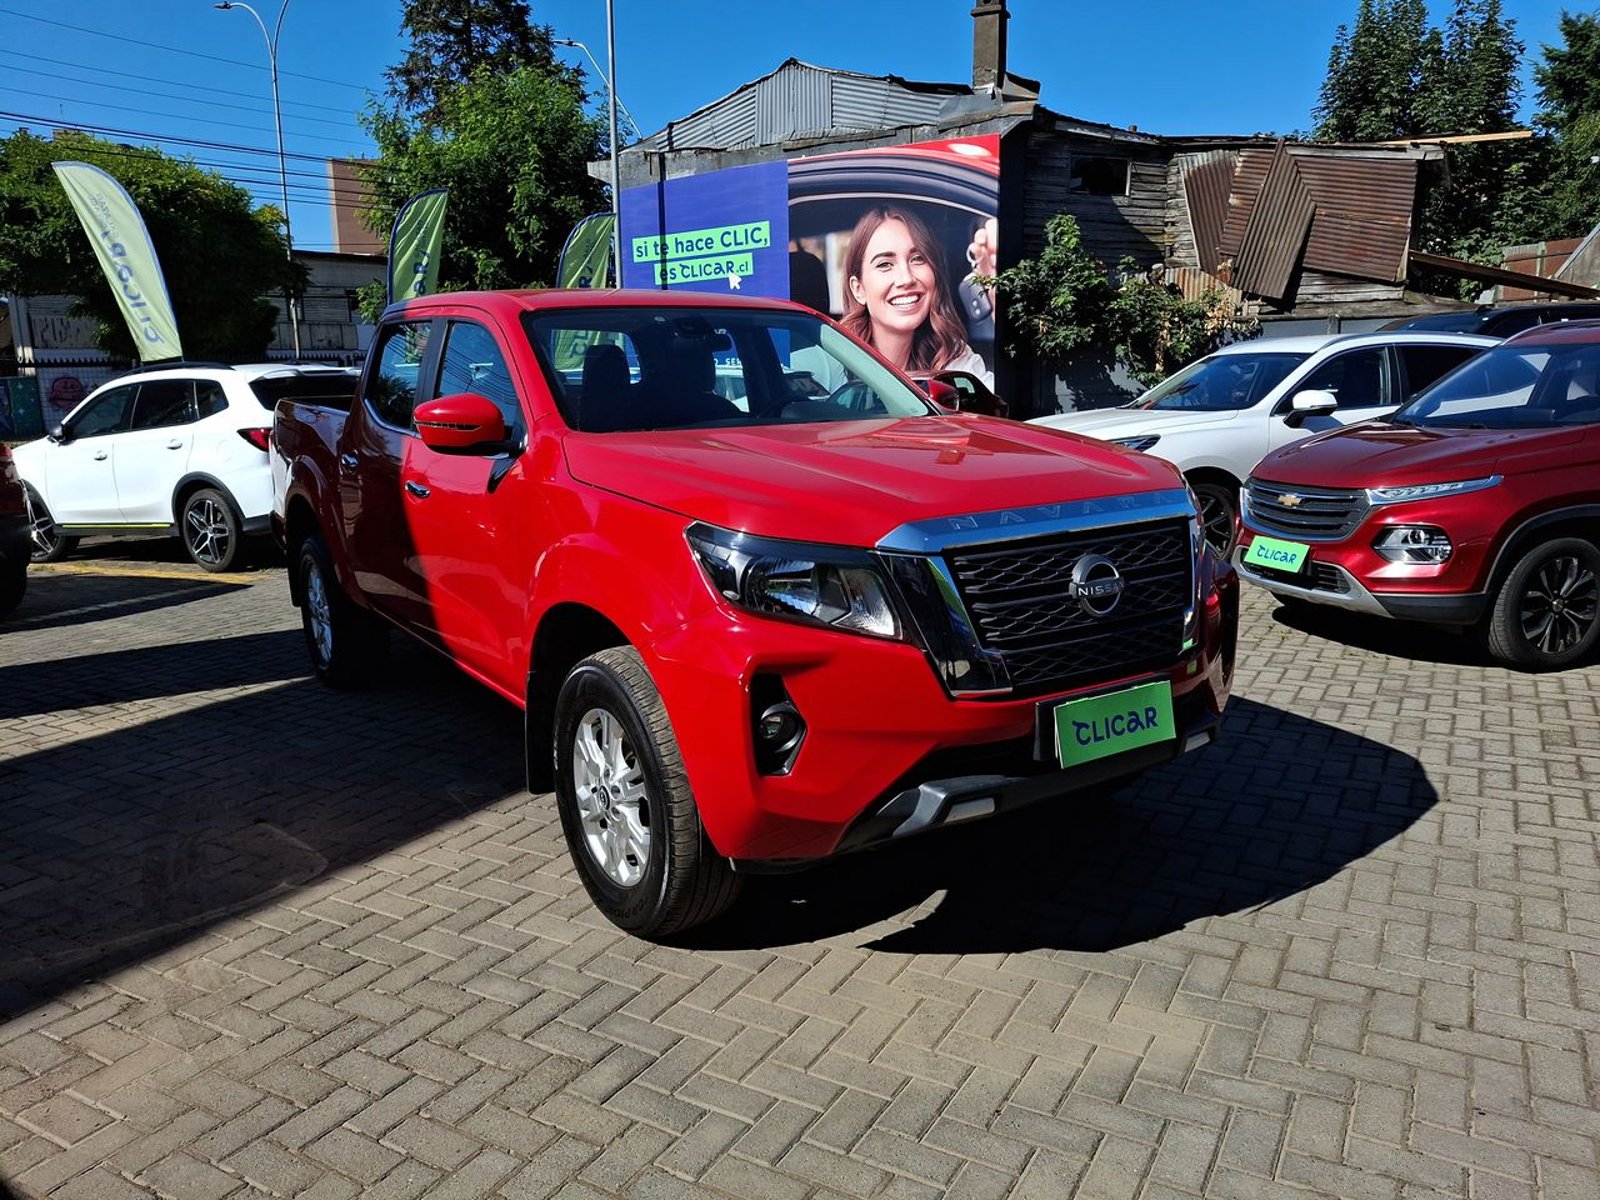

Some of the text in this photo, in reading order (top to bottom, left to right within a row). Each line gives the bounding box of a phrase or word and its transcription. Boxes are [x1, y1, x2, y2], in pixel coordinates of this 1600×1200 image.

[635, 227, 768, 258] si te hace CLIC,
[660, 268, 677, 280] es
[948, 491, 1172, 531] NAVARA
